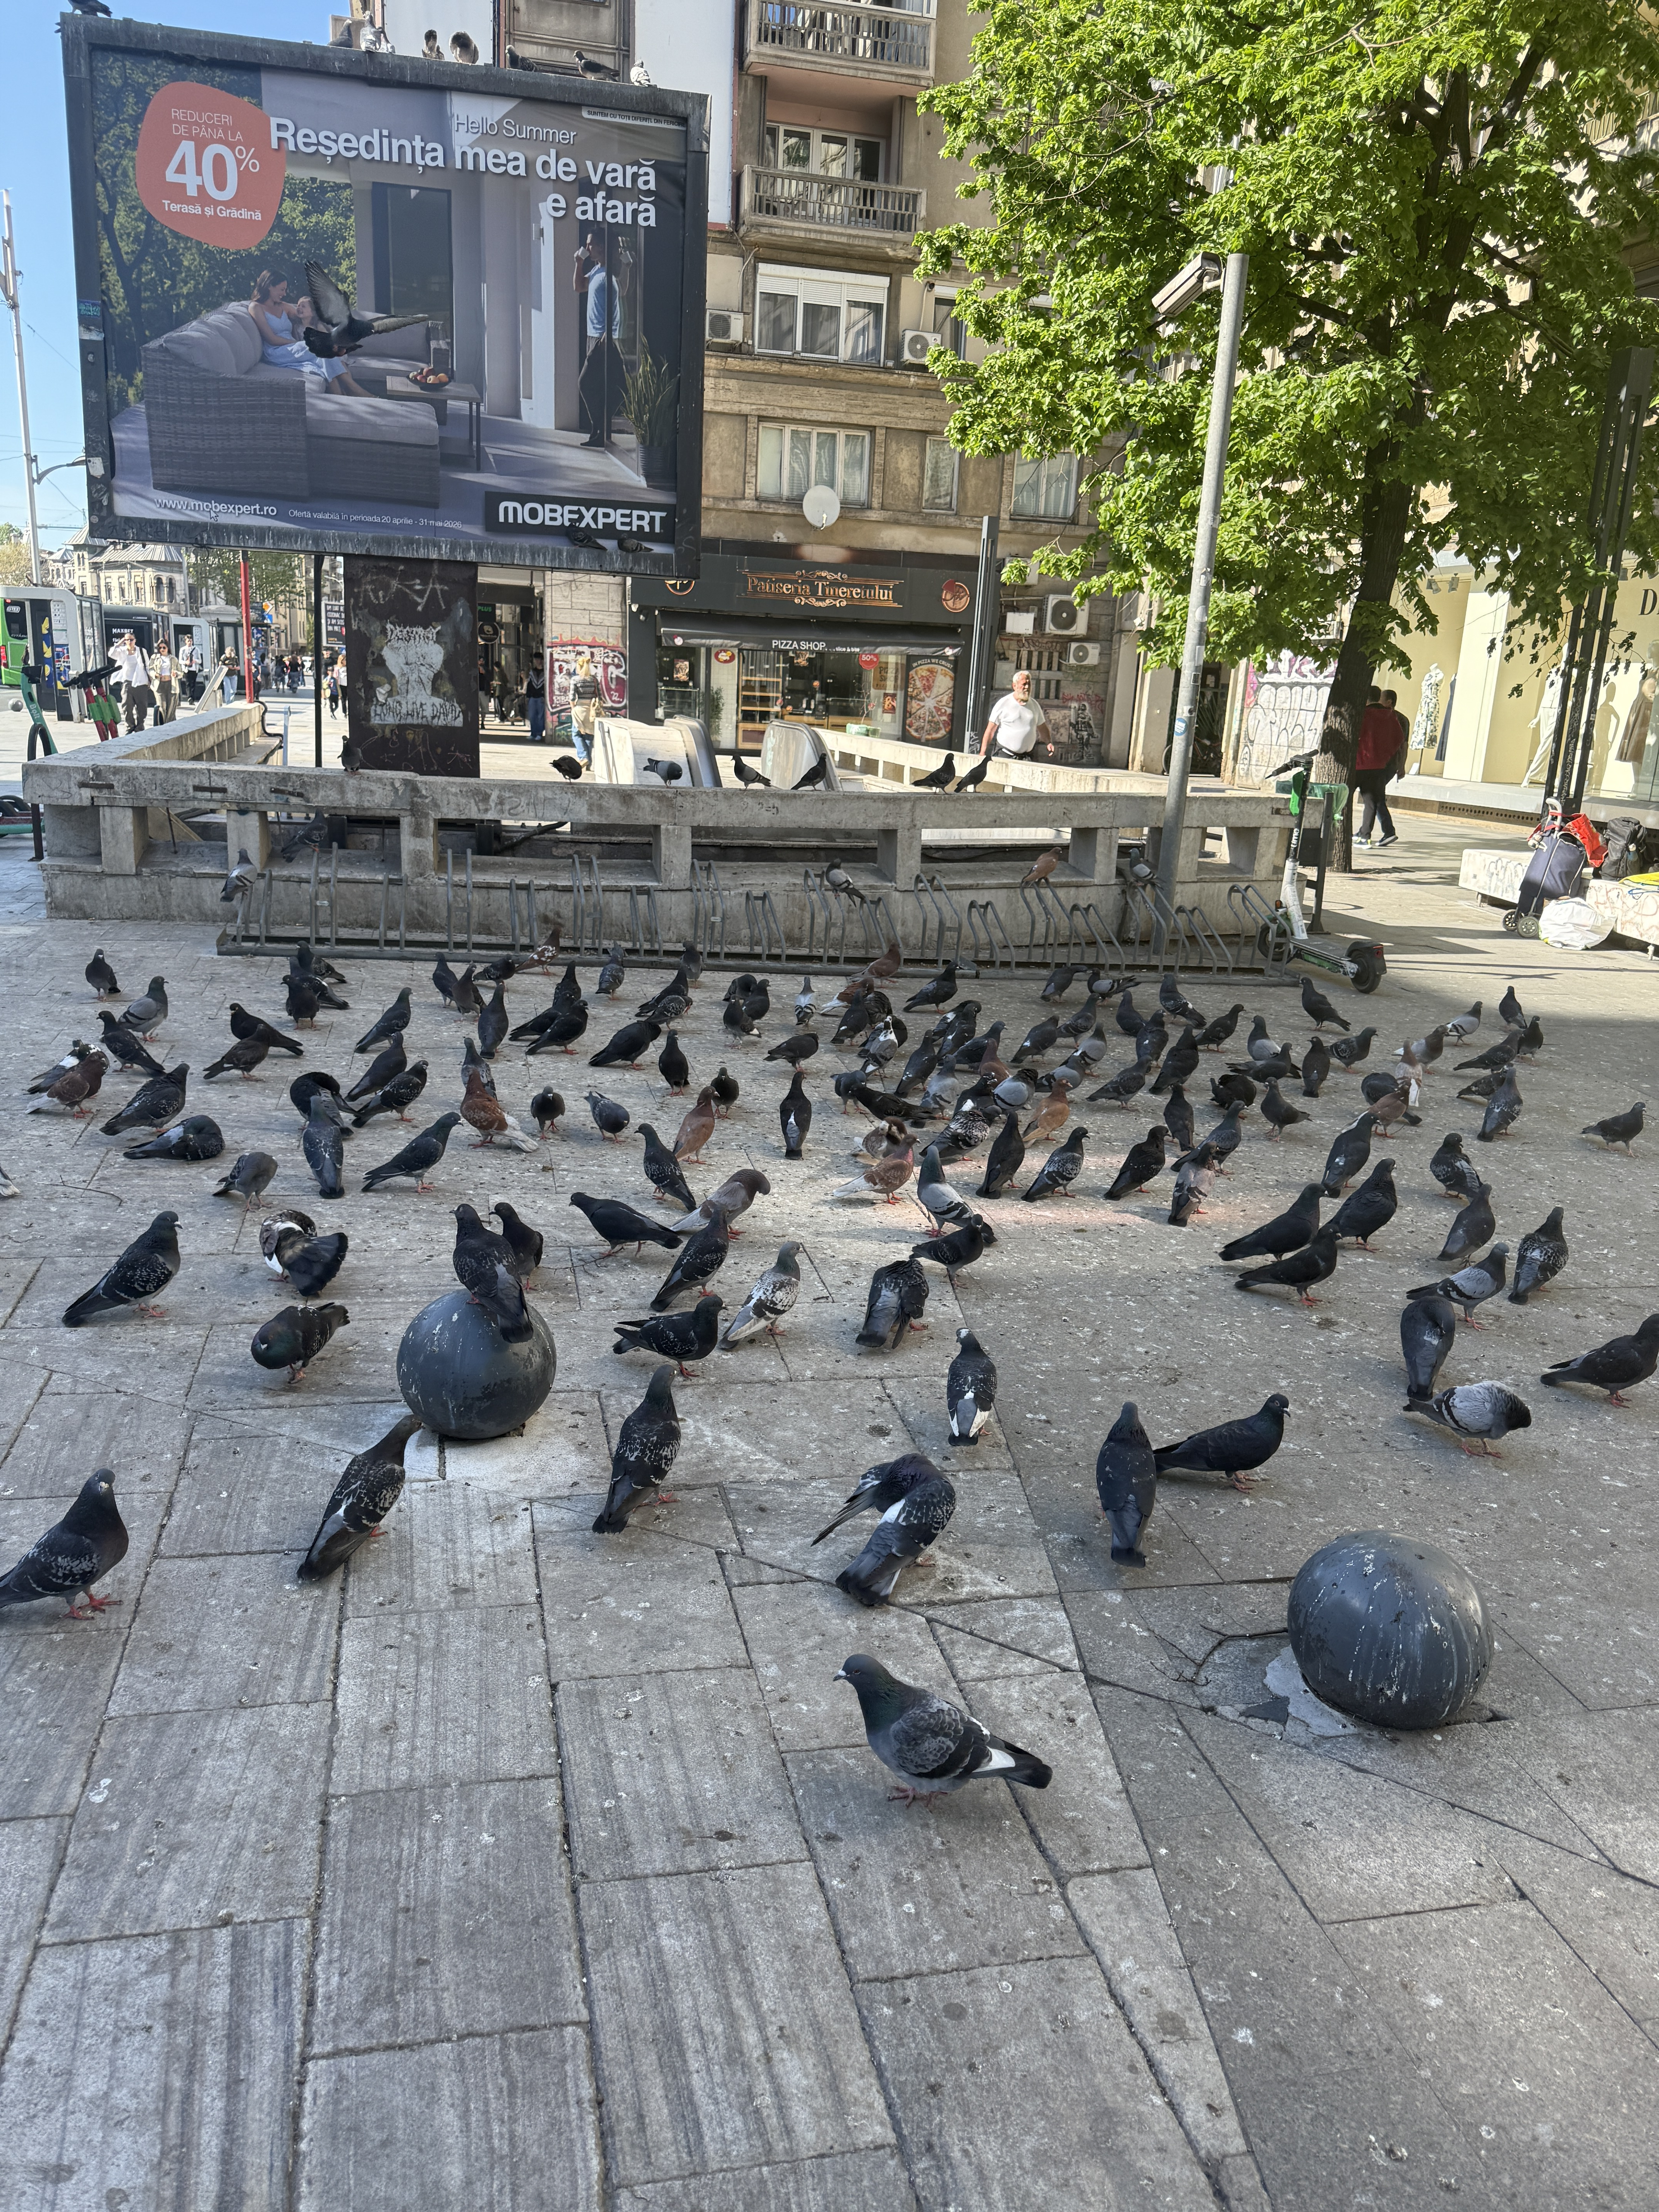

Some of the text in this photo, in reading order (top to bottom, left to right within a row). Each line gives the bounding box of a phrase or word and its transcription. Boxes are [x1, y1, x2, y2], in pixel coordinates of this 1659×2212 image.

[171, 109, 232, 125] REDUCERI
[172, 124, 243, 142] DE PÂNĂ LA
[455, 114, 577, 145] Hello Summer
[270, 117, 656, 191] Reședința mea de vară
[163, 200, 261, 221] Terasă și Grădină
[546, 191, 656, 227] e afară
[155, 499, 277, 516] www.mobexpert.ro
[289, 509, 311, 518] Ofertă
[350, 514, 380, 522] perioada
[499, 501, 667, 533] MOBEXPERT
[747, 577, 893, 601] Patiseria Tineretului
[1638, 589, 1659, 616] D
[772, 640, 799, 649] PIZZA
[29, 704, 40, 719] Bolt
